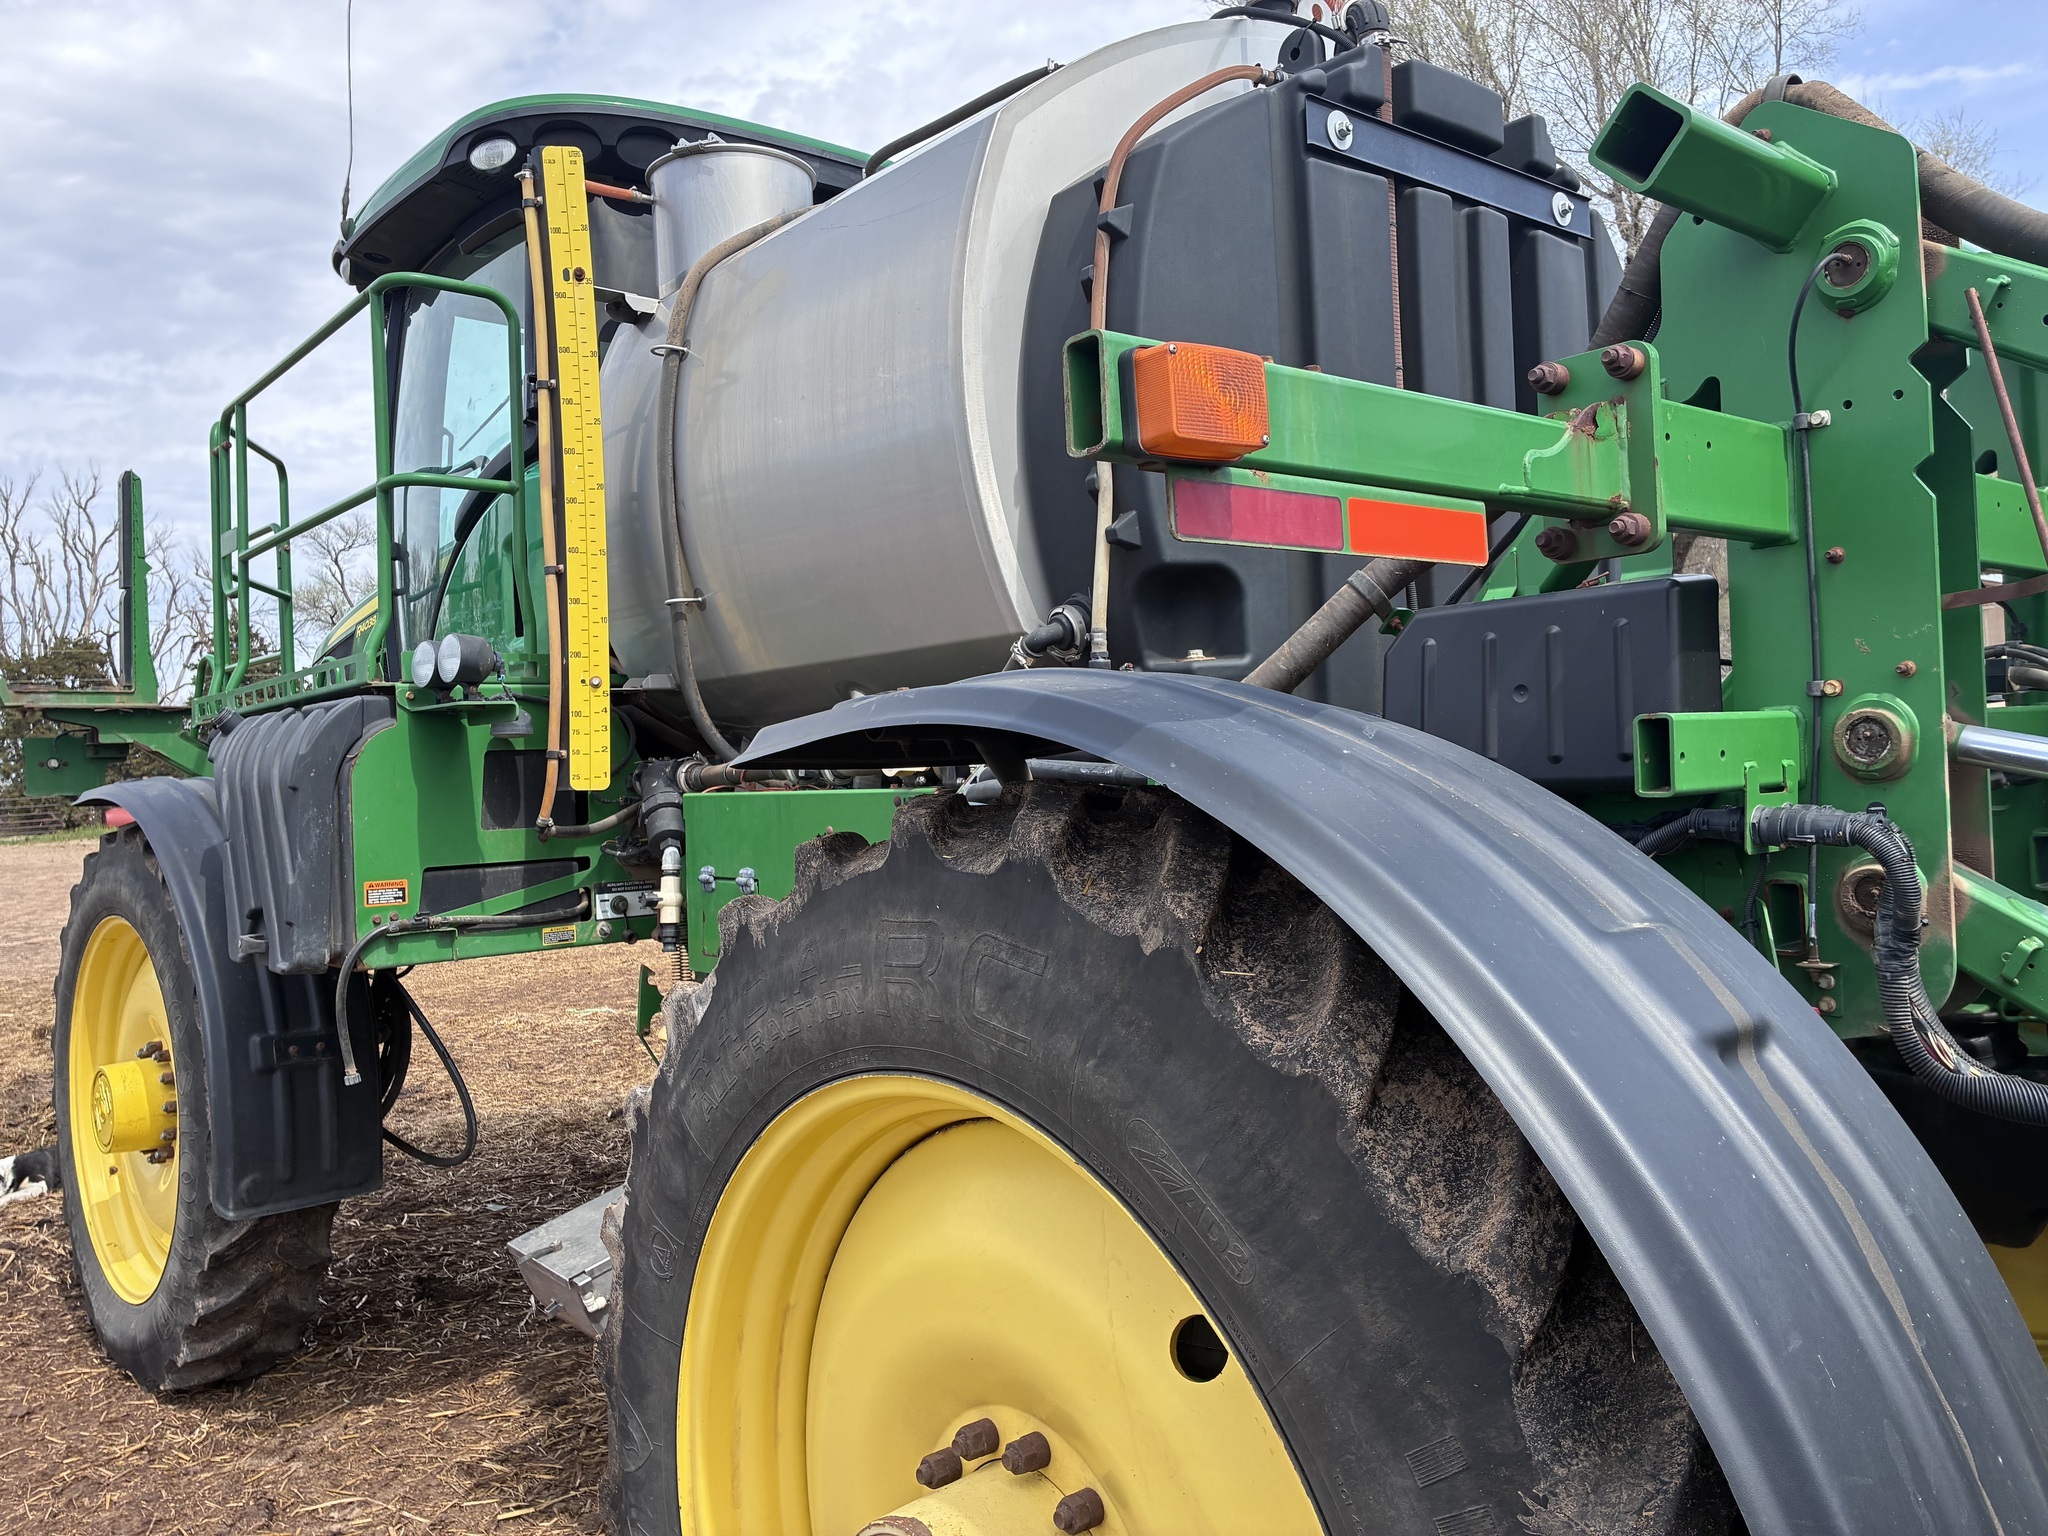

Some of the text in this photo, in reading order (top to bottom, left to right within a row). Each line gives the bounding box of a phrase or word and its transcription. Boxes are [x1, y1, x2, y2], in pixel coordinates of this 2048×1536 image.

[550, 226, 561, 236] 1000
[580, 223, 590, 233] 38
[584, 277, 593, 286] 35
[555, 291, 567, 300] 900
[559, 346, 571, 354] 800
[590, 350, 598, 359] 30
[562, 397, 573, 406] 700
[594, 418, 601, 426] 25
[564, 447, 575, 455] 600
[597, 482, 606, 491] 20
[566, 497, 578, 505] 500
[567, 546, 579, 554] 400
[568, 597, 580, 605] 300
[600, 616, 608, 624] 10
[569, 651, 582, 659] 200
[571, 710, 583, 718] 100
[572, 748, 581, 756] 50
[572, 773, 581, 781] 25
[700, 984, 864, 1122] ALL TRACTION
